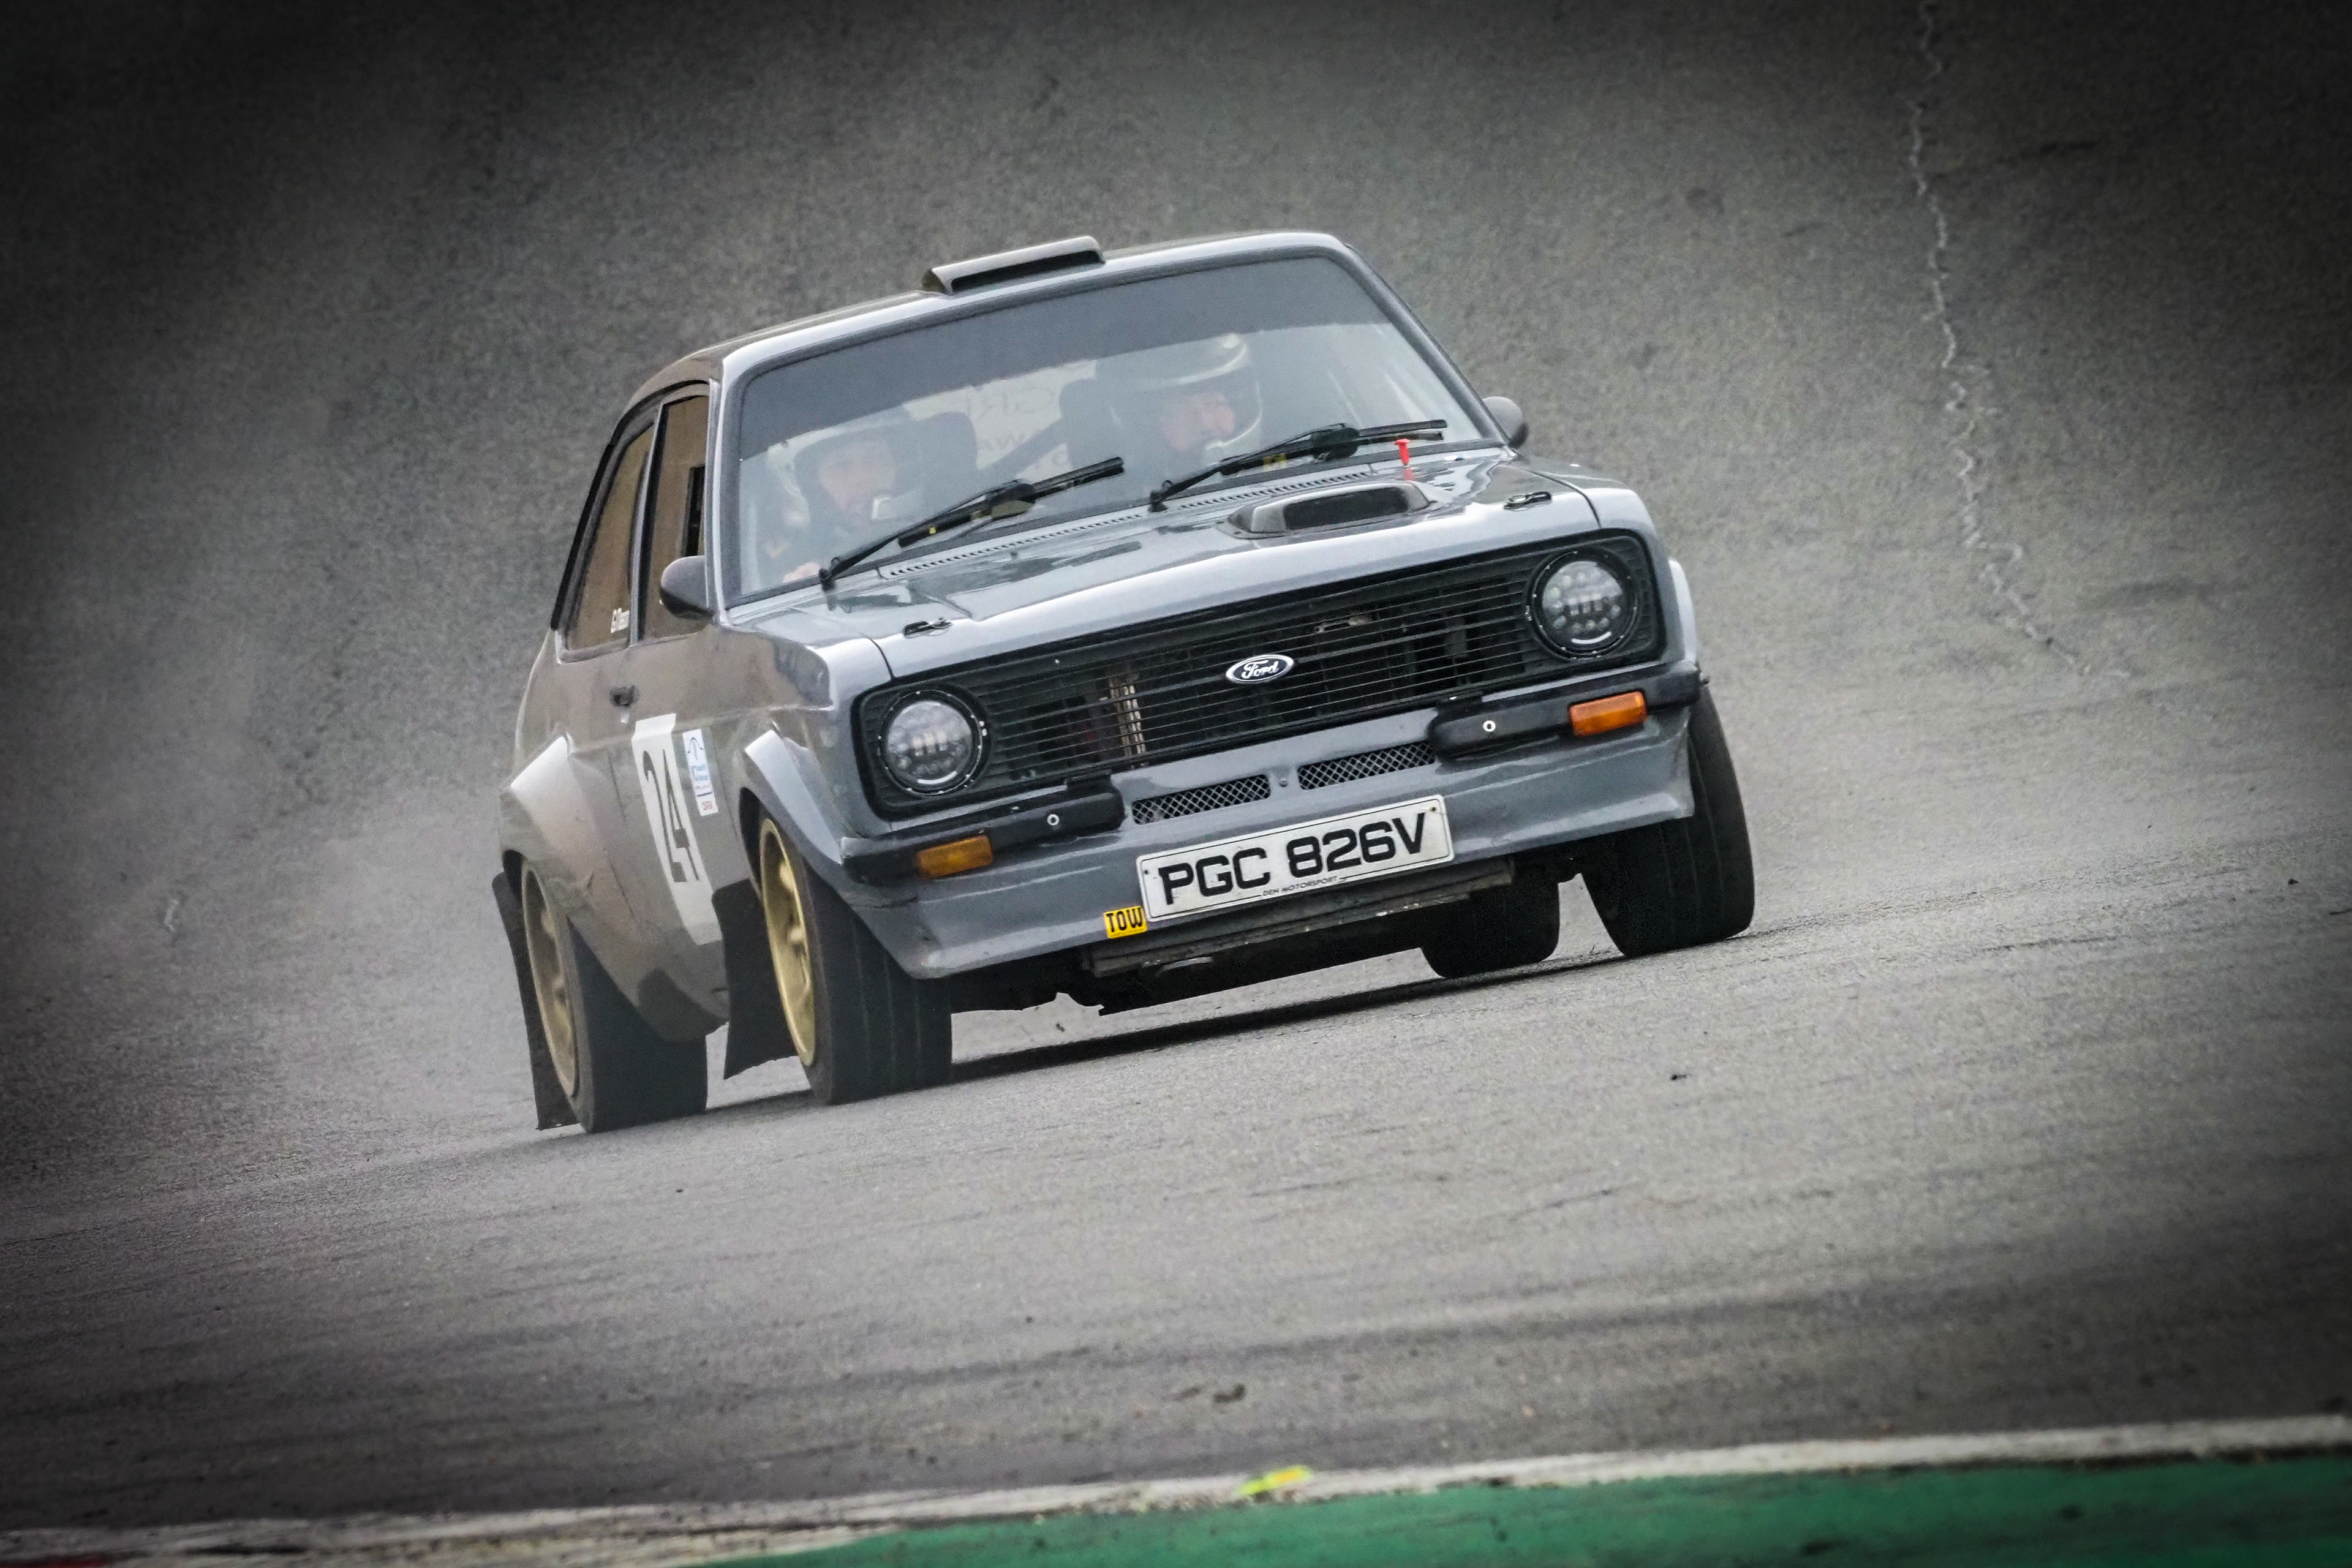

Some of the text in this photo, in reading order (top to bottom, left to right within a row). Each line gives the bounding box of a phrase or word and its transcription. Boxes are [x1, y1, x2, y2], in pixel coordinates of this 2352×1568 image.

[1241, 660, 1280, 679] Ford
[643, 750, 699, 882] 24
[1158, 813, 1424, 905] PGC 826V
[1281, 876, 1338, 892] MOTORSPORT
[1106, 907, 1143, 932] TOW
